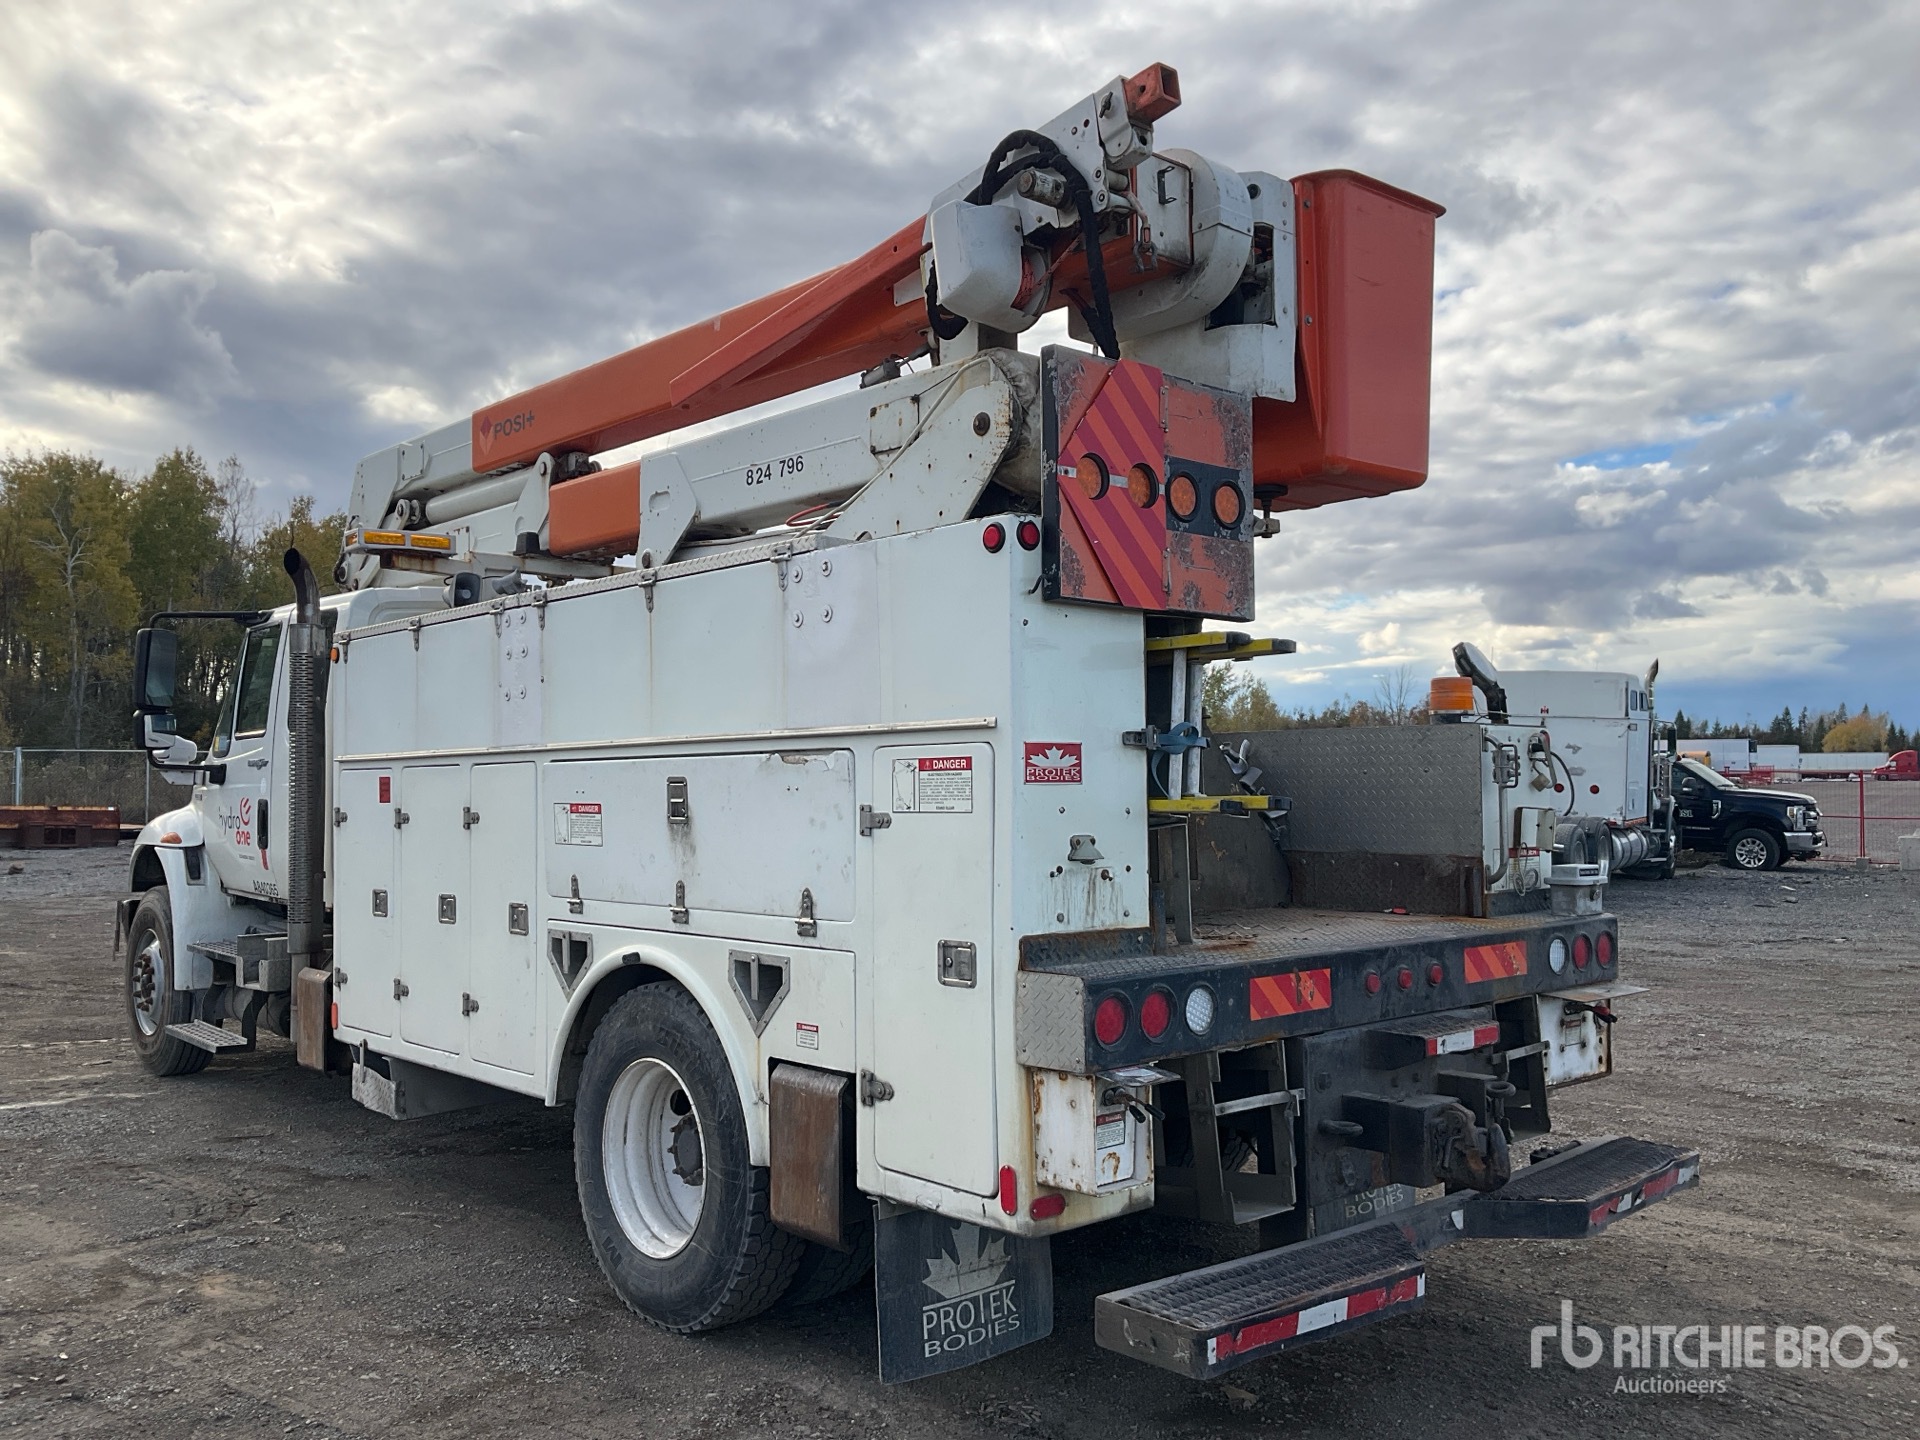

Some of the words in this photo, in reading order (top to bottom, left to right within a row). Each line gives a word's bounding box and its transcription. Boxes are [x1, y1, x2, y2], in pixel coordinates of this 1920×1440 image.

[746, 463, 772, 486] 824
[779, 455, 804, 477] 796
[932, 759, 967, 769] DANGER
[1026, 767, 1080, 776] PROTEK
[578, 805, 599, 813] DANGER
[235, 830, 251, 847] one
[1345, 1188, 1404, 1218] BODIES
[922, 1285, 1017, 1340] PROTEK
[924, 1314, 1021, 1358] BODIES
